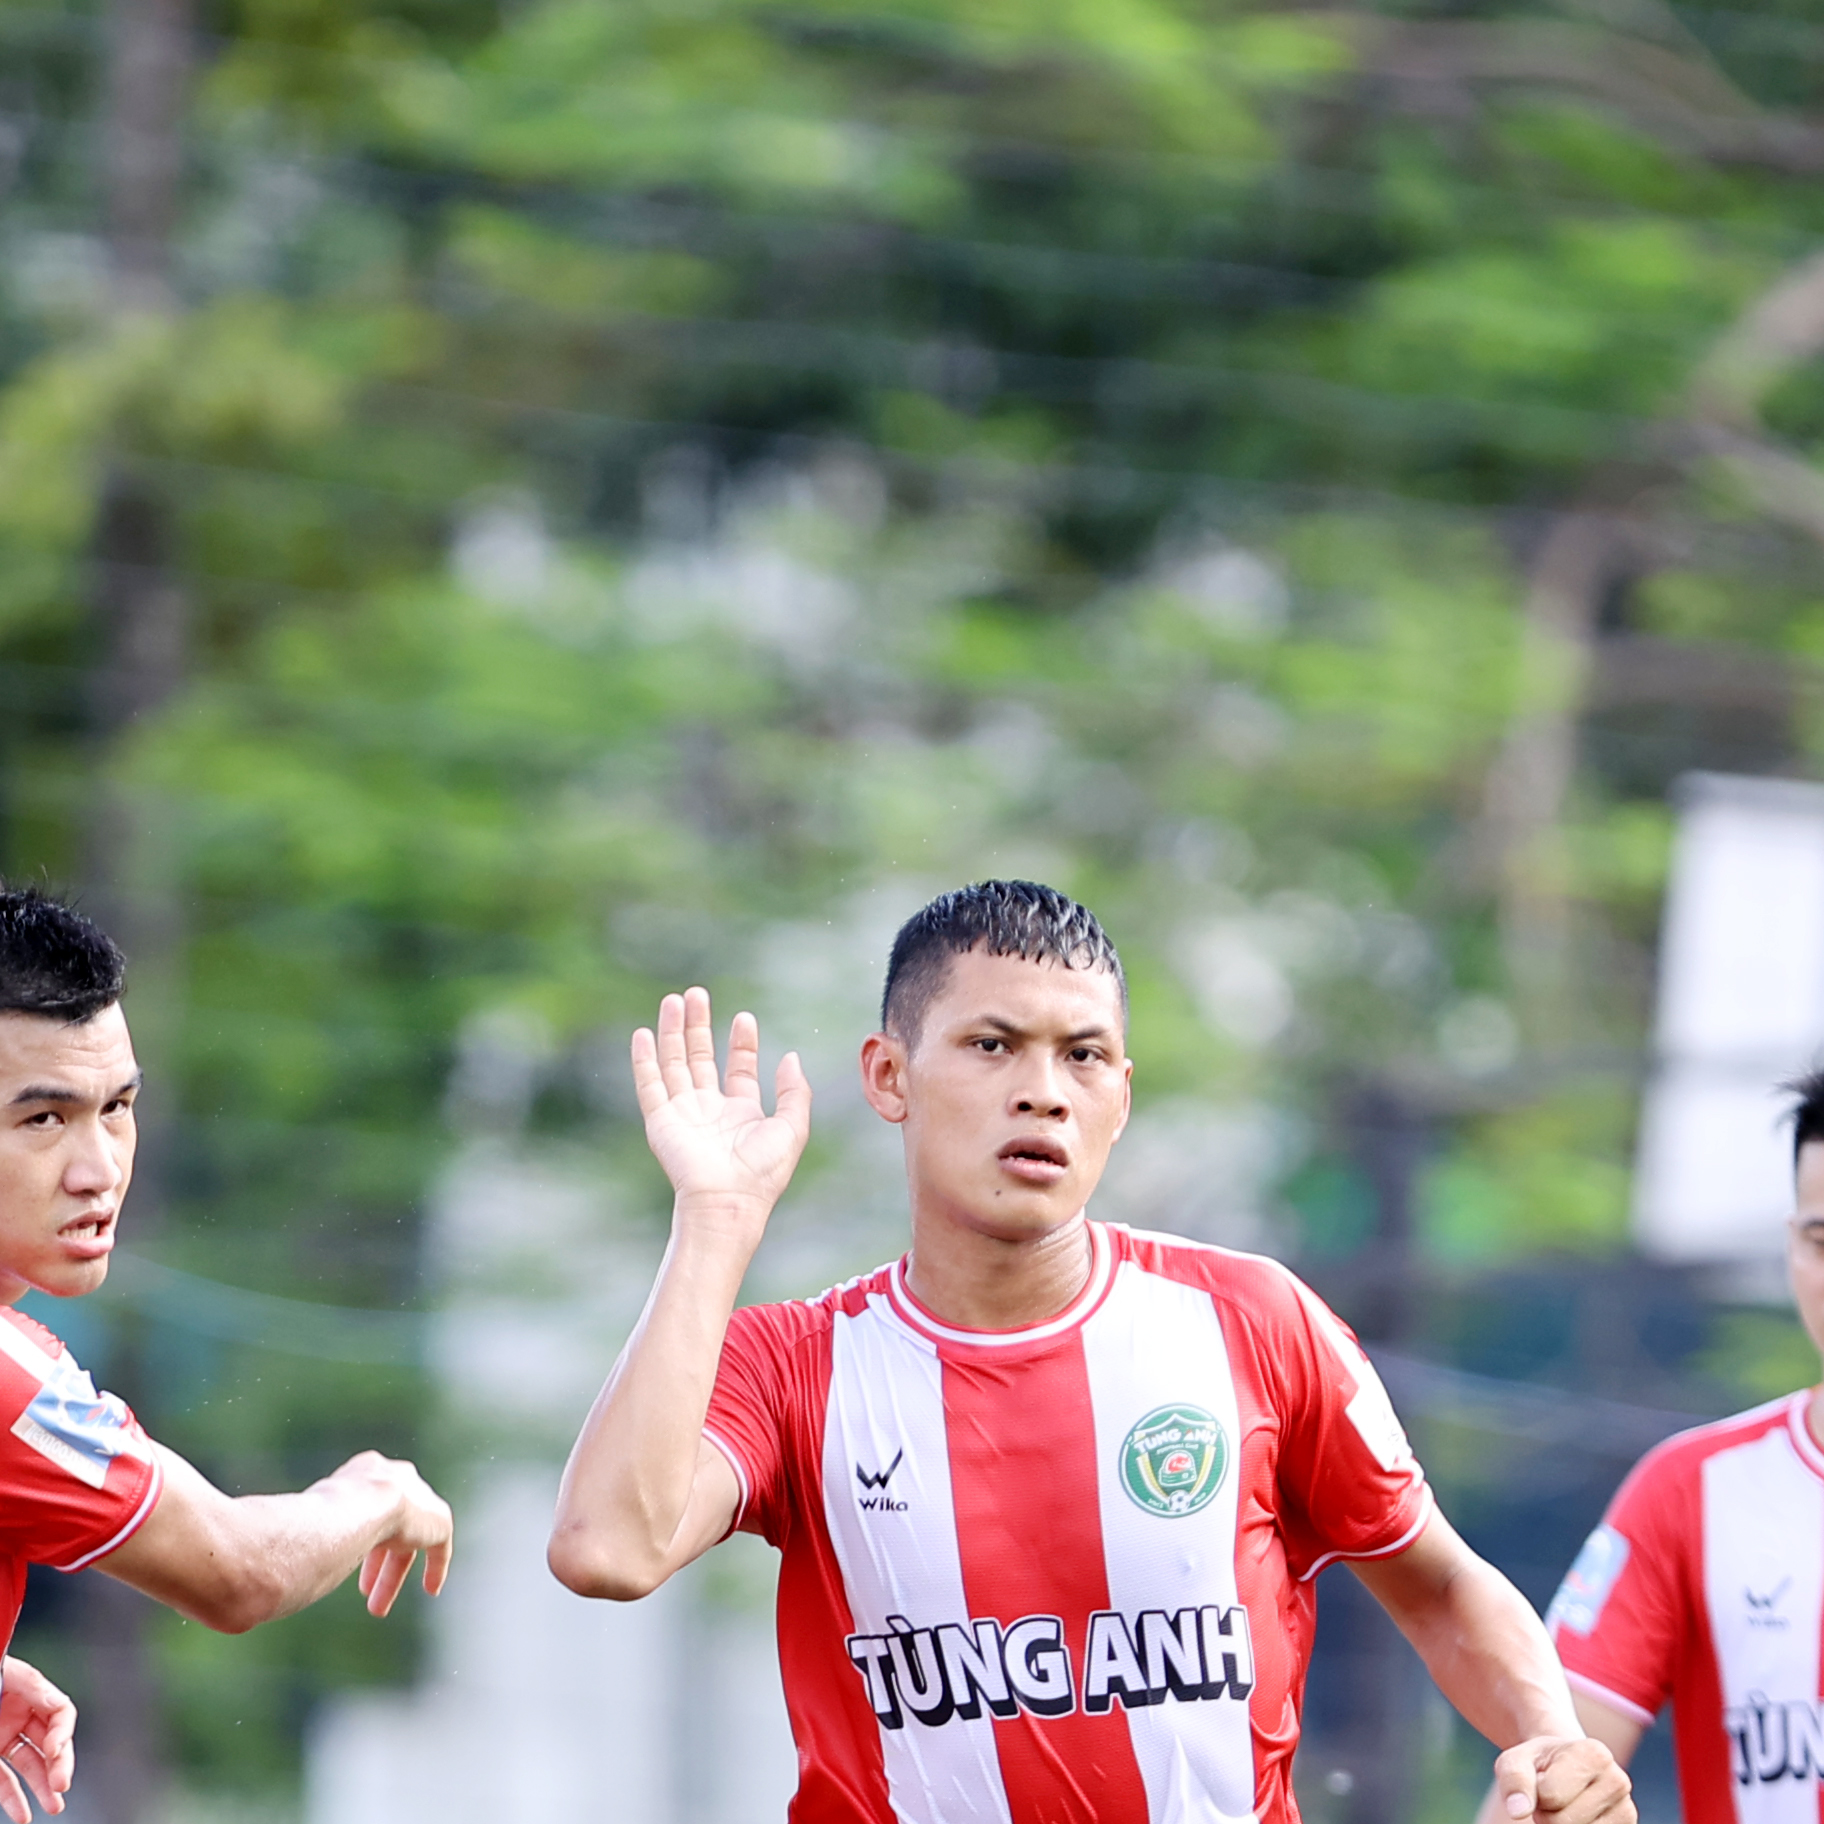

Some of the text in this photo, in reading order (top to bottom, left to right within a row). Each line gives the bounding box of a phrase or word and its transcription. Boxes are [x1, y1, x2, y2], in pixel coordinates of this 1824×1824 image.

[858, 1496, 908, 1512] Wika
[844, 1605, 1252, 1731] TÙNG ANH
